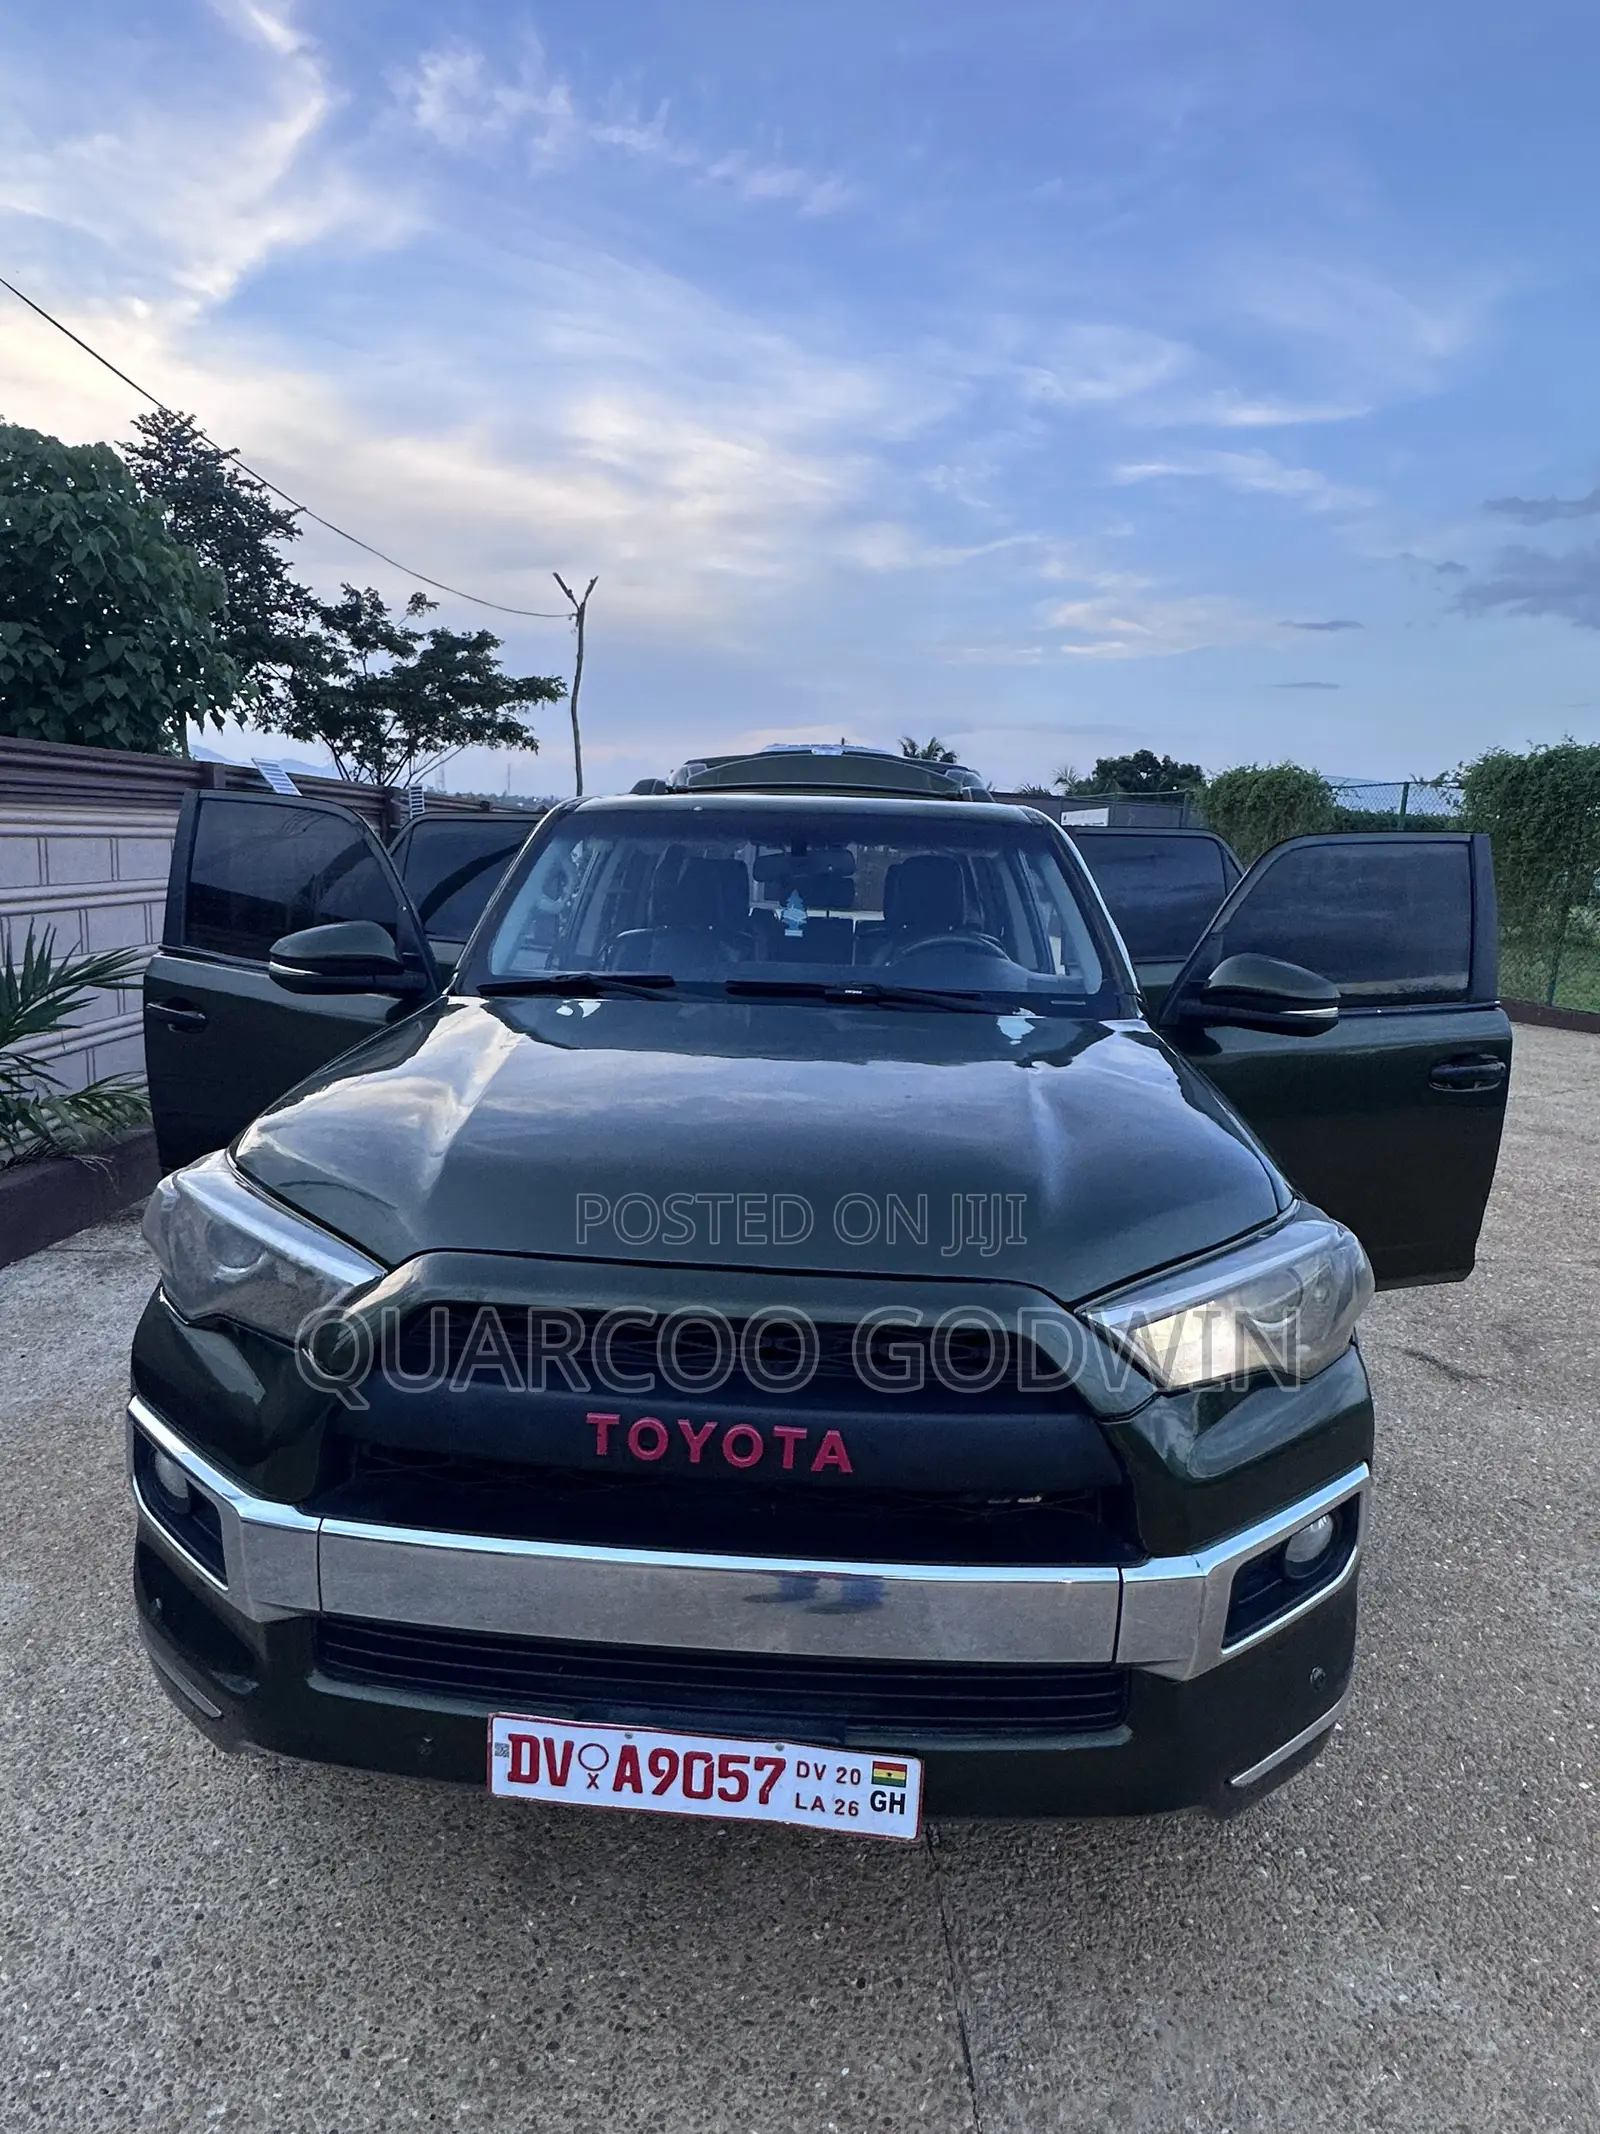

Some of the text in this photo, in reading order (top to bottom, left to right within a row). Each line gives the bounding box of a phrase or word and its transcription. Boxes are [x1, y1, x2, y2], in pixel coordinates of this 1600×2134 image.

[586, 1412, 854, 1474] TOYOTA
[507, 1733, 787, 1805] DV A9057
[796, 1760, 861, 1785] DV 20
[795, 1792, 859, 1817] LA 26
[869, 1789, 906, 1815] GH
